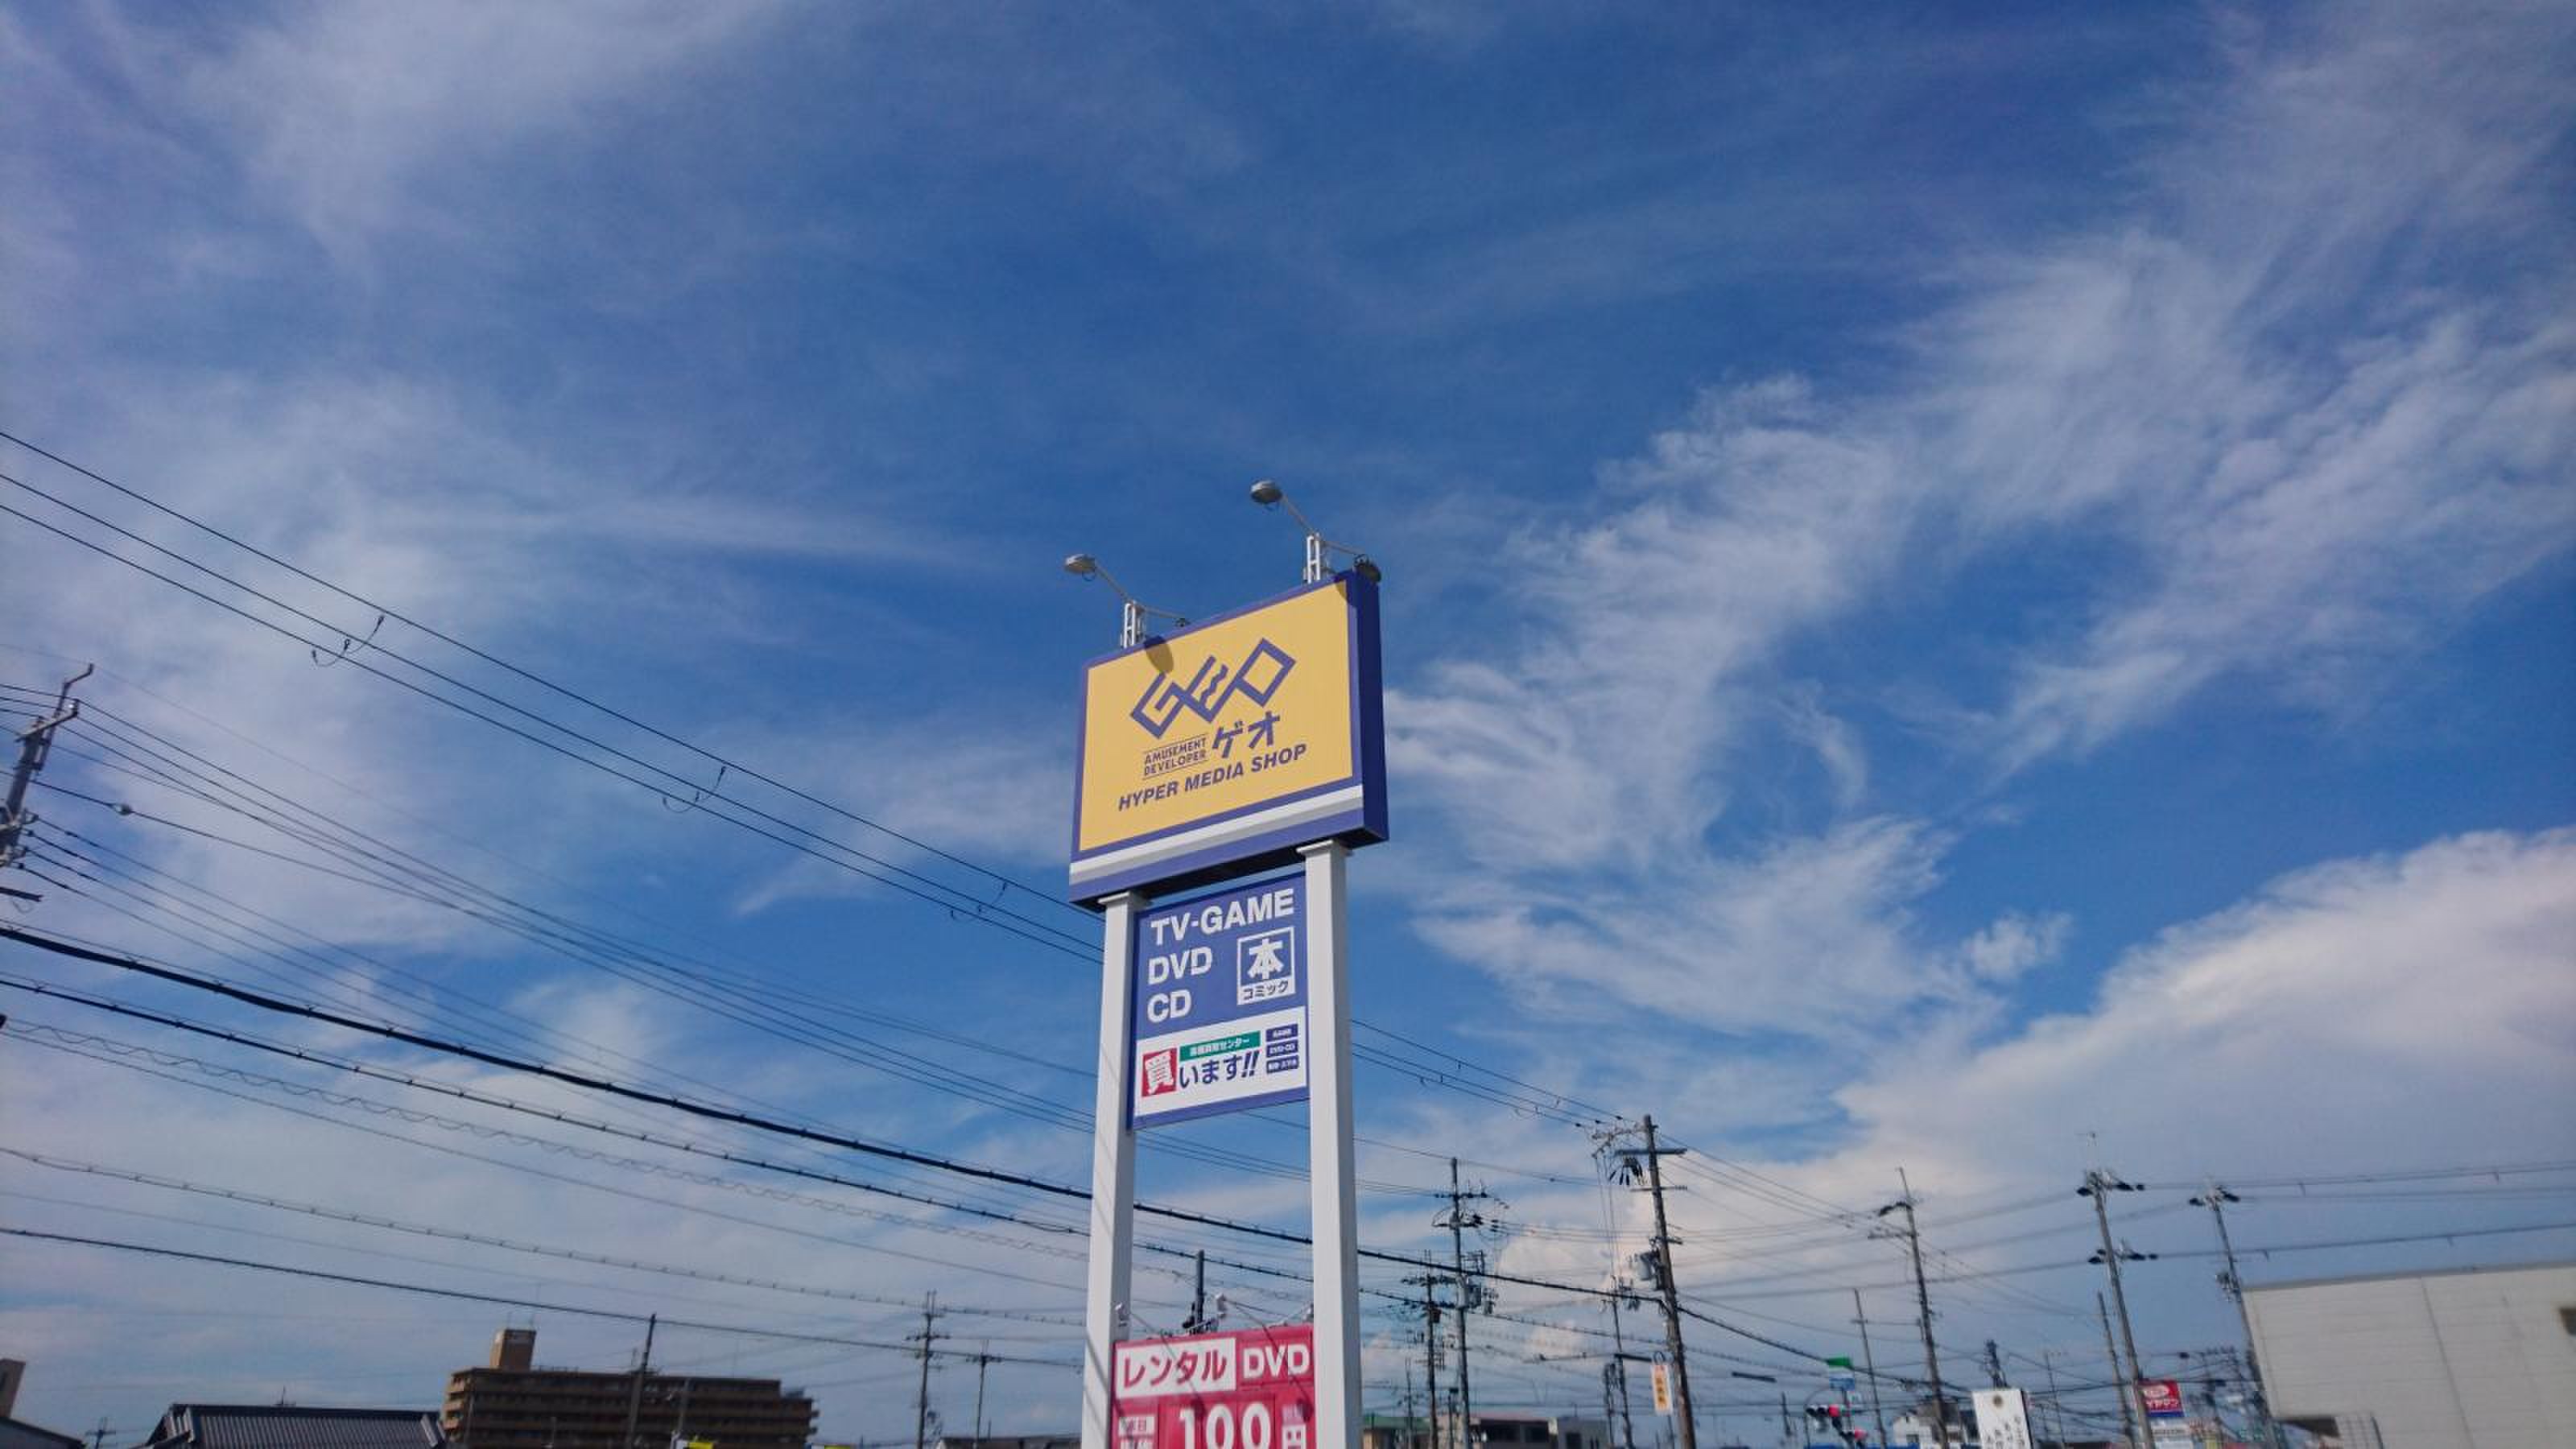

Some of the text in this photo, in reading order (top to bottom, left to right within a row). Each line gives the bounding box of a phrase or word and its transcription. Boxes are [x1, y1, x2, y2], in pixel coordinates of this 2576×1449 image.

[1144, 737, 1207, 765] AMUSEMENT
[1212, 711, 1281, 758] ゲオ
[1118, 743, 1307, 811] HYPER MEDIA SHOP
[1144, 749, 1207, 777] DEVELOPER
[1150, 888, 1294, 946] TV-GAME
[1148, 946, 1213, 985] DVD
[1248, 938, 1285, 980] 本
[1146, 989, 1192, 1023] CD
[1243, 980, 1289, 1001] コミック
[1123, 1344, 1311, 1389] レンタル DVD
